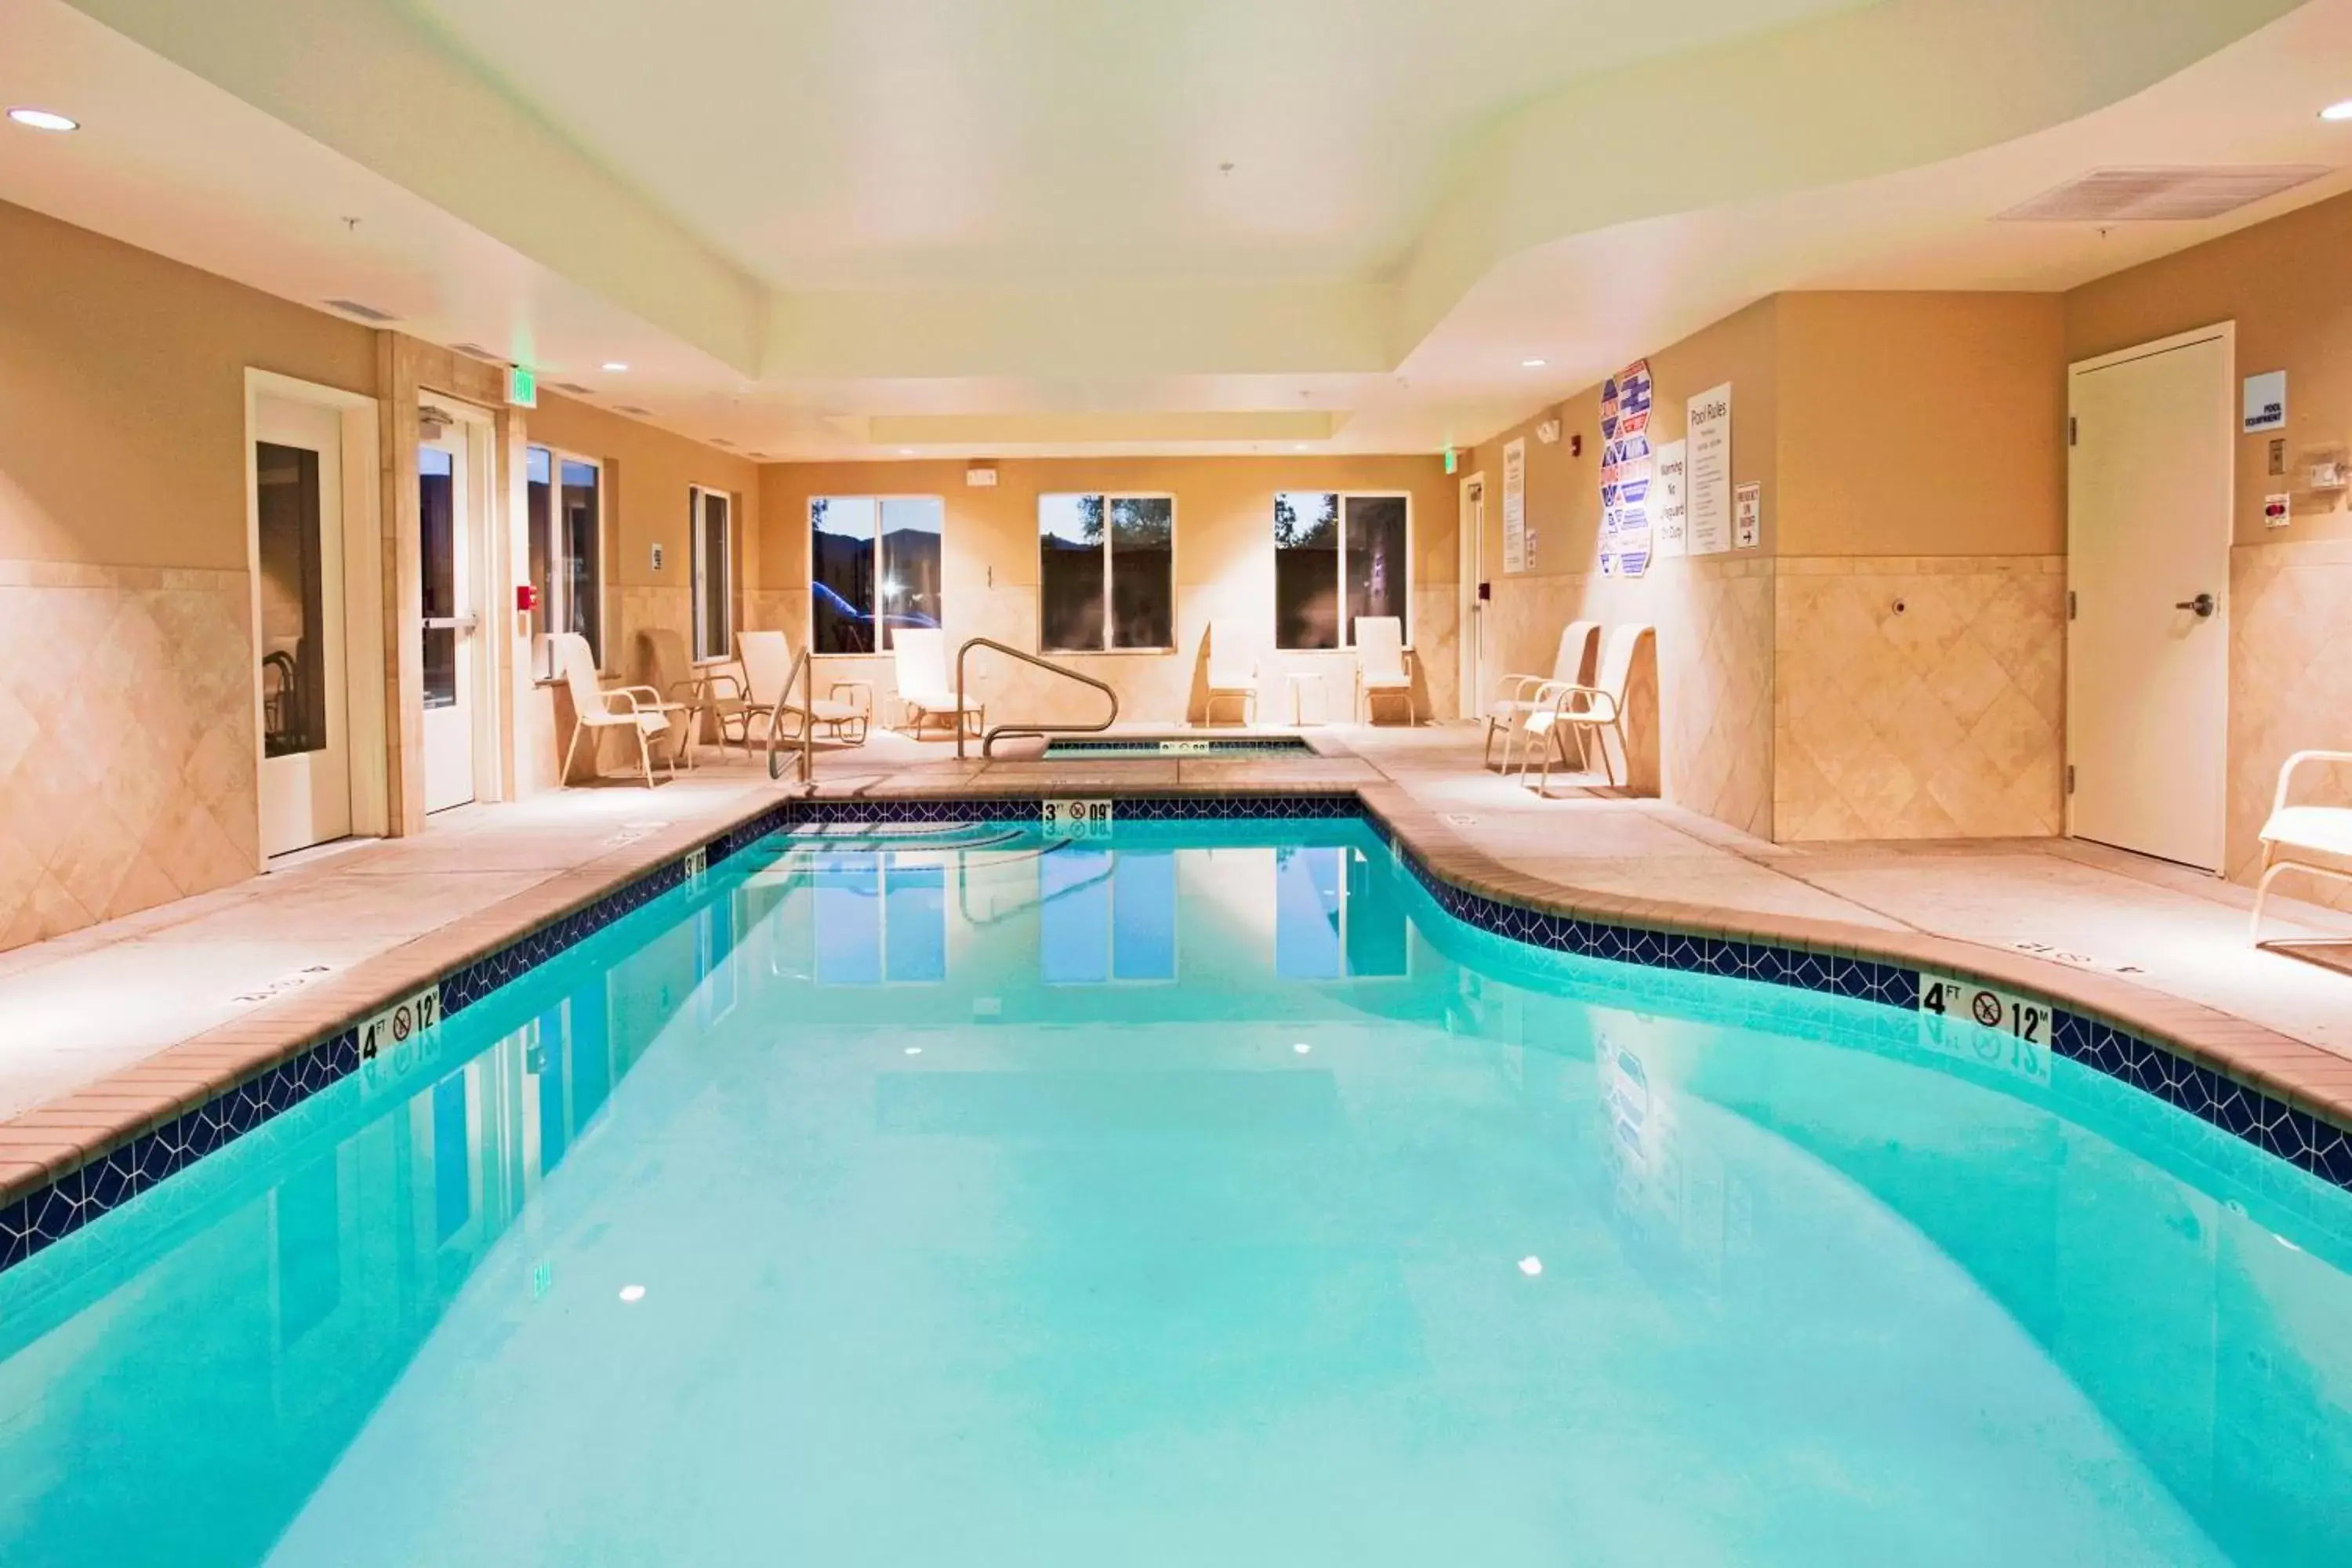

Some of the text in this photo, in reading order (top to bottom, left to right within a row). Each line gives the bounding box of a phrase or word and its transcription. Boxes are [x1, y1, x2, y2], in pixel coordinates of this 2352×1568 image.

[1691, 401, 1727, 428] Pool Rules
[1045, 804, 1056, 821] 3
[1089, 804, 1106, 821] 09
[363, 1024, 378, 1061] 4
[416, 994, 434, 1033] 12
[1924, 982, 1946, 1015] 4
[2012, 1002, 2038, 1044] 12
